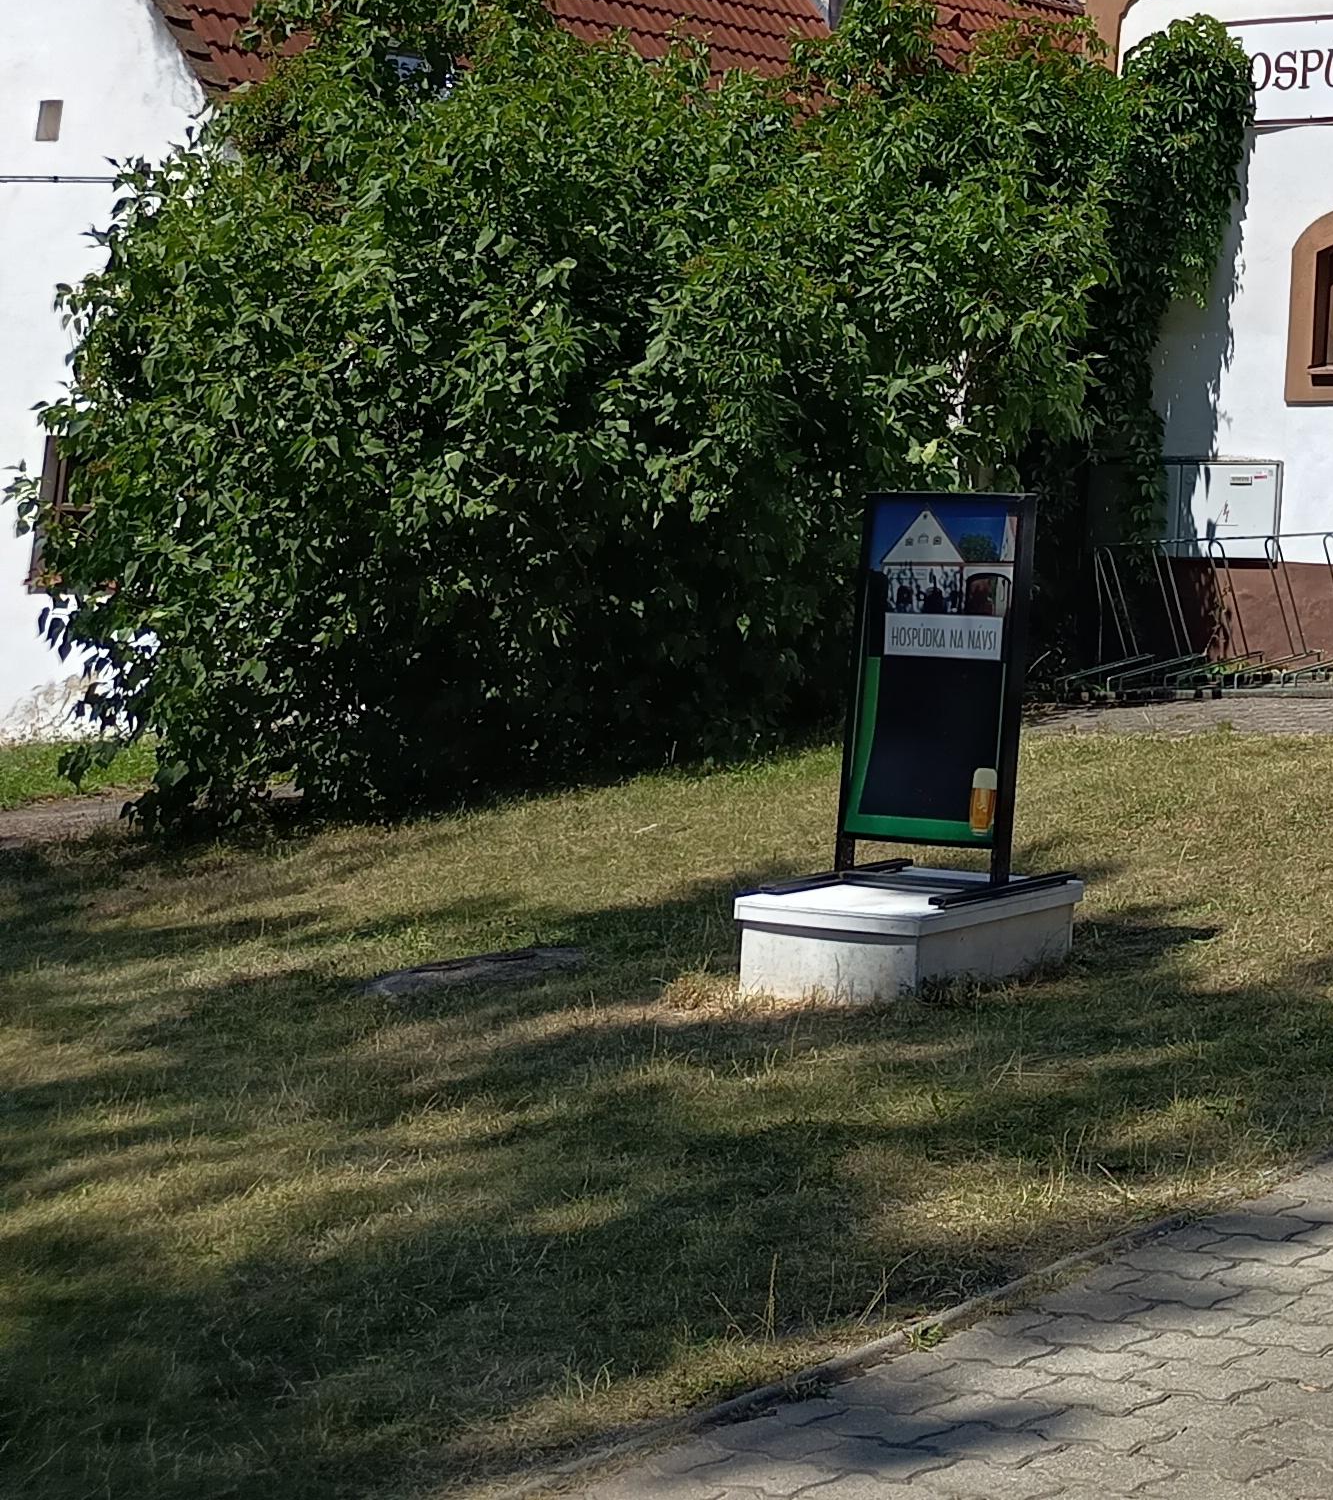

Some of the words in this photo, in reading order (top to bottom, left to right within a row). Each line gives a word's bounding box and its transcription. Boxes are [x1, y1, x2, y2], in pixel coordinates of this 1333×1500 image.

[890, 622, 946, 649] HOSPŮDKA
[949, 629, 964, 649] NA
[967, 623, 997, 651] NÁVSI
